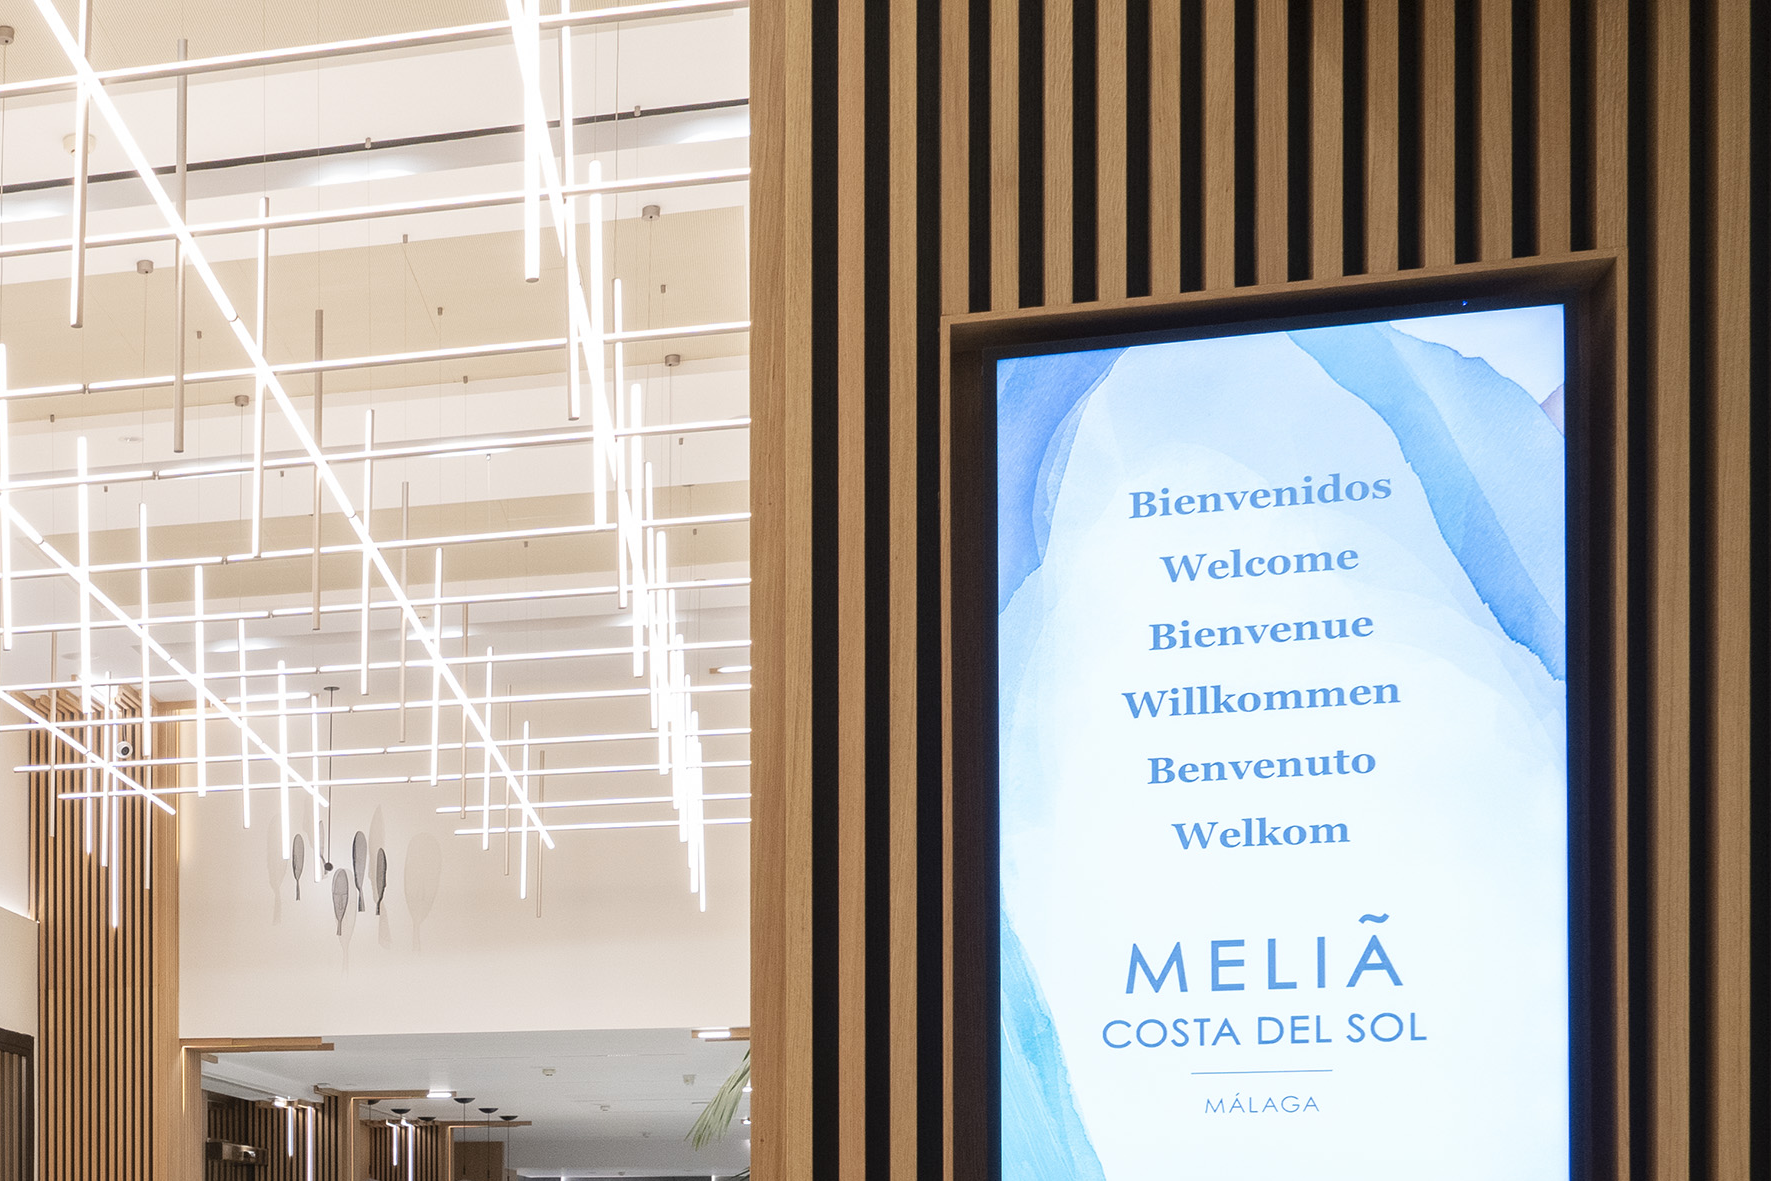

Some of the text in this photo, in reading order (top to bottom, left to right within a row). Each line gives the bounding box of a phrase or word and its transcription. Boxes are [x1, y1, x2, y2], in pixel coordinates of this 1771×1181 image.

[1128, 472, 1392, 520] Bienvenidos
[1158, 548, 1360, 584] Welcome
[1147, 616, 1375, 652] Bienvenue
[1120, 683, 1402, 720] Willkommen
[1146, 749, 1377, 785] Benvenuto
[1170, 816, 1352, 851] Welkom
[1124, 912, 1404, 995] MELIÃ
[1101, 1011, 1428, 1050] COSTA DEL SOL
[1204, 1092, 1320, 1114] MÁLAGA
